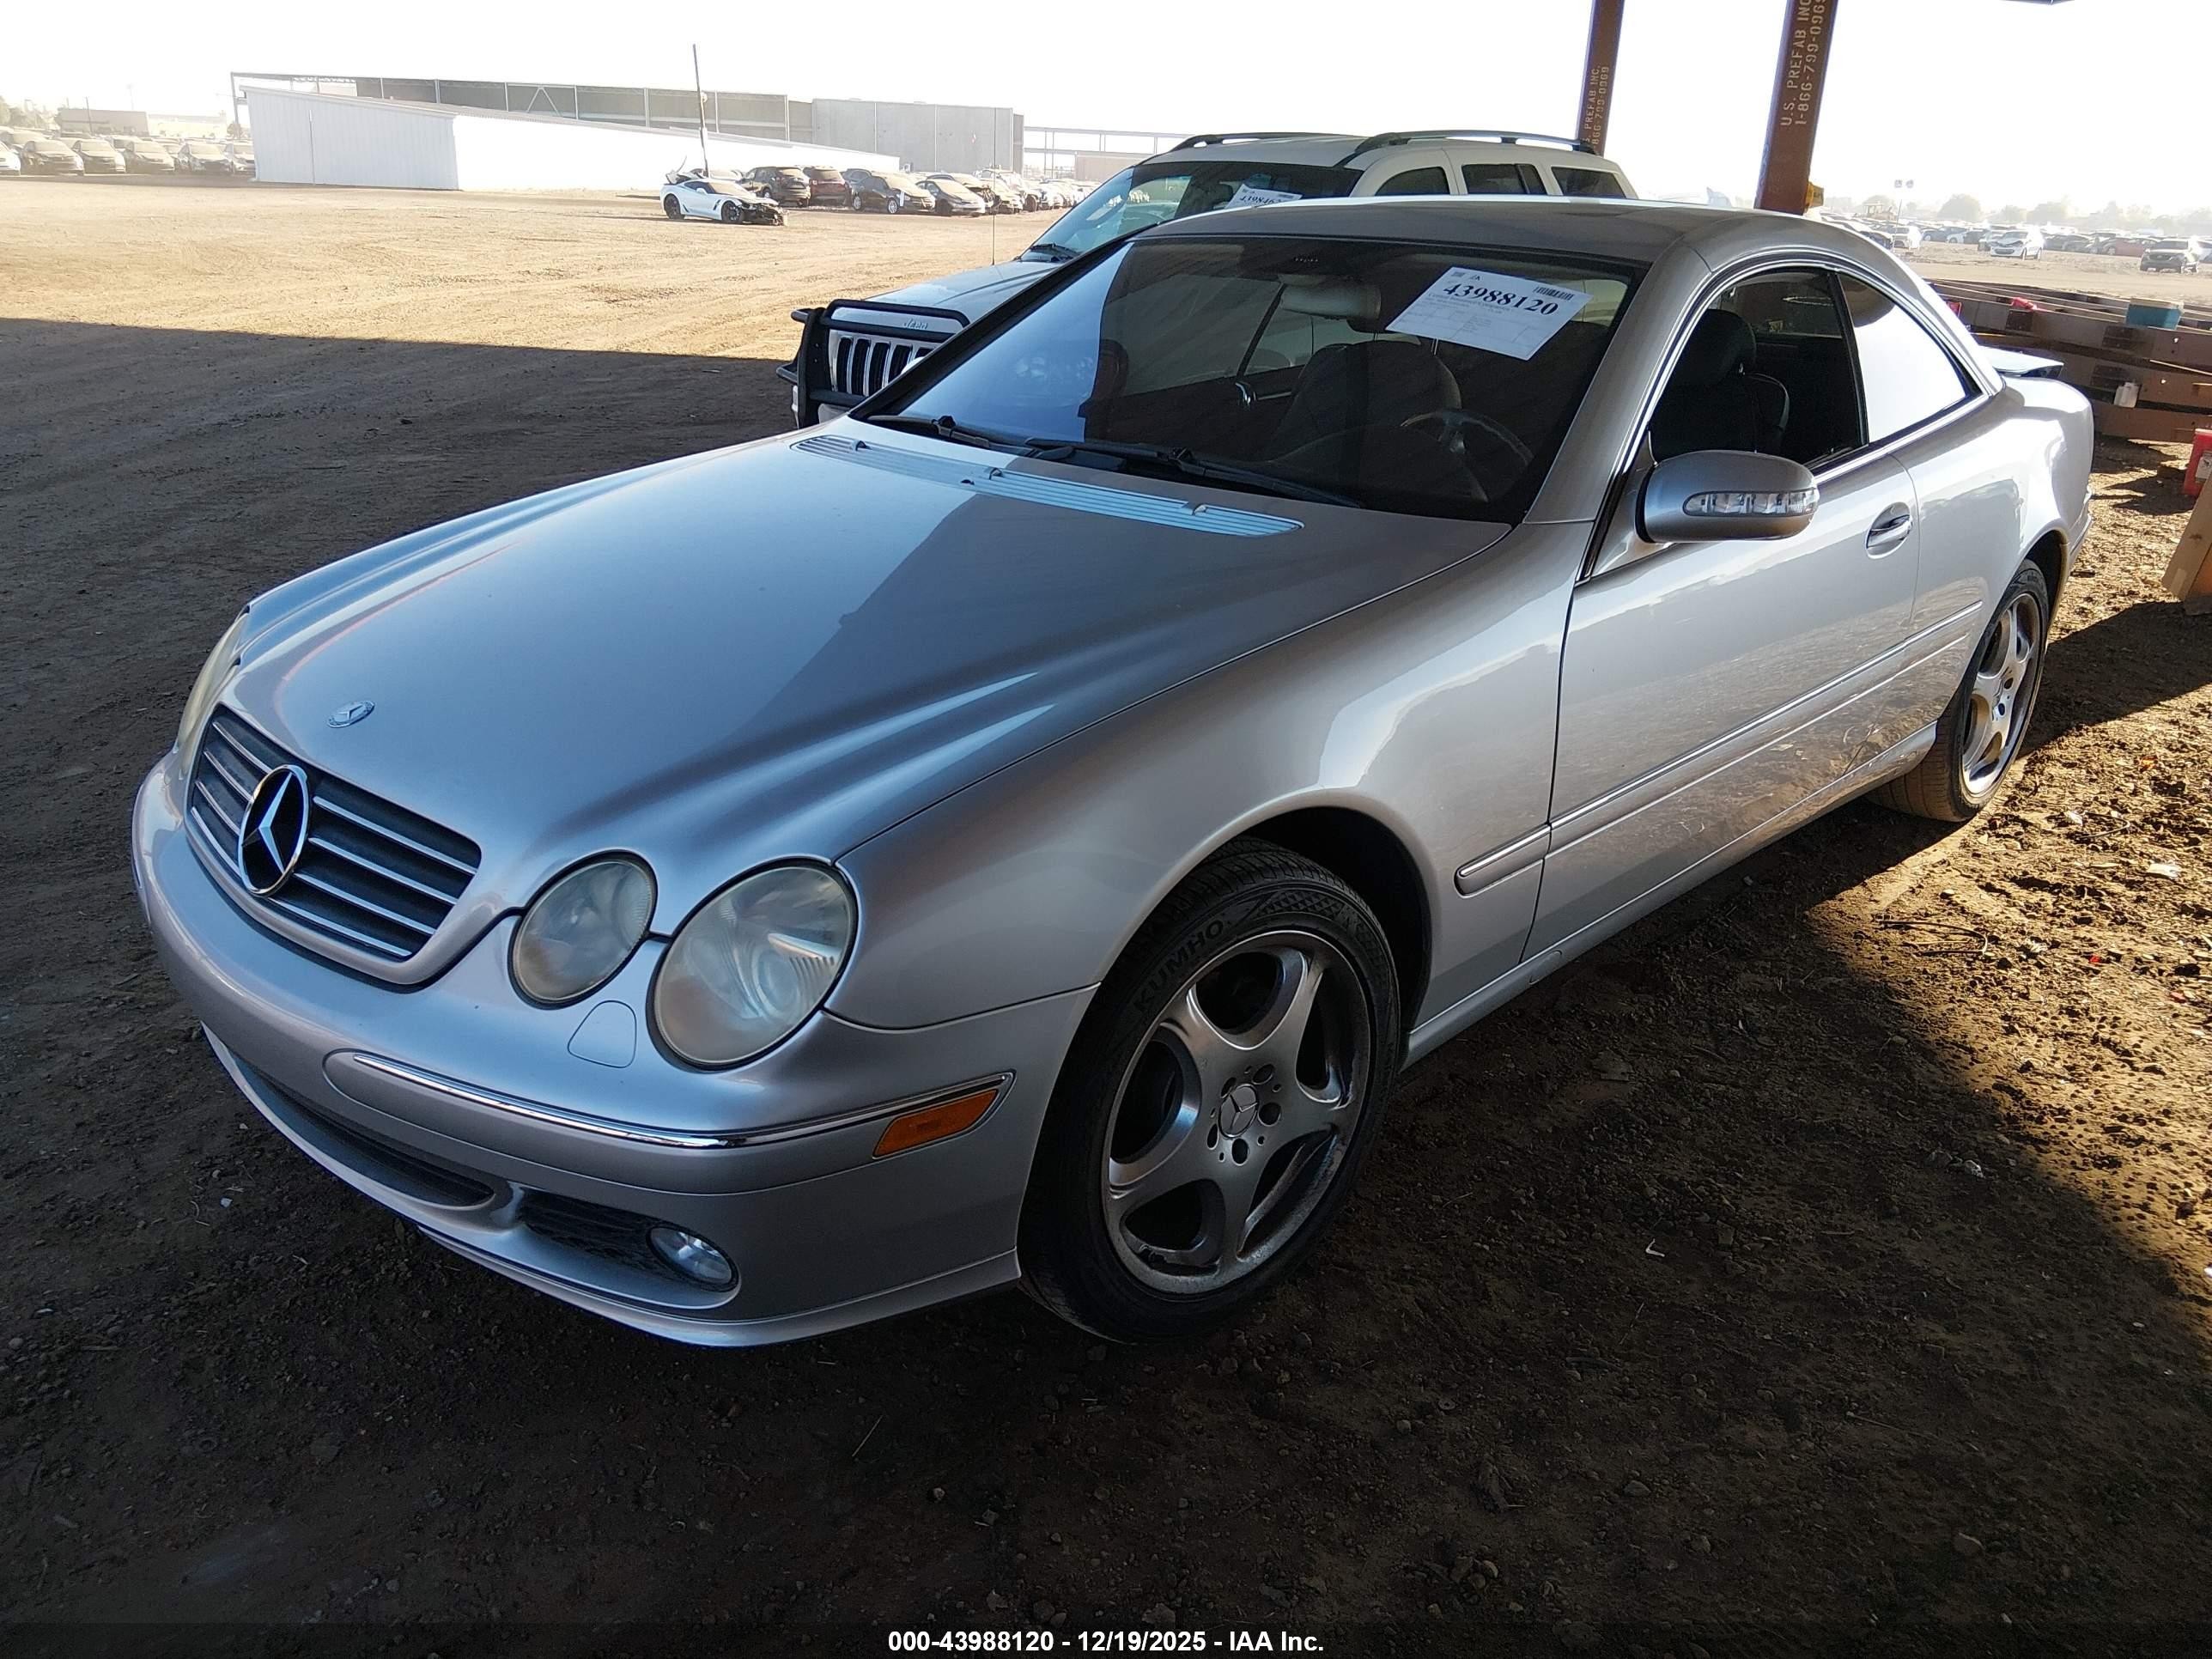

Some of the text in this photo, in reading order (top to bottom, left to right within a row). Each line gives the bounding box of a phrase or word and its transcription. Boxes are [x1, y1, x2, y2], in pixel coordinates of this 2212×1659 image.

[1786, 28, 1807, 88] PREFAB
[1795, 0, 1827, 125] 1-866-799-096
[1583, 89, 1597, 130] PREFAB
[1779, 97, 1797, 126] U.S.
[1443, 283, 1559, 315] 43988120
[1133, 919, 1224, 1012] KUMHO
